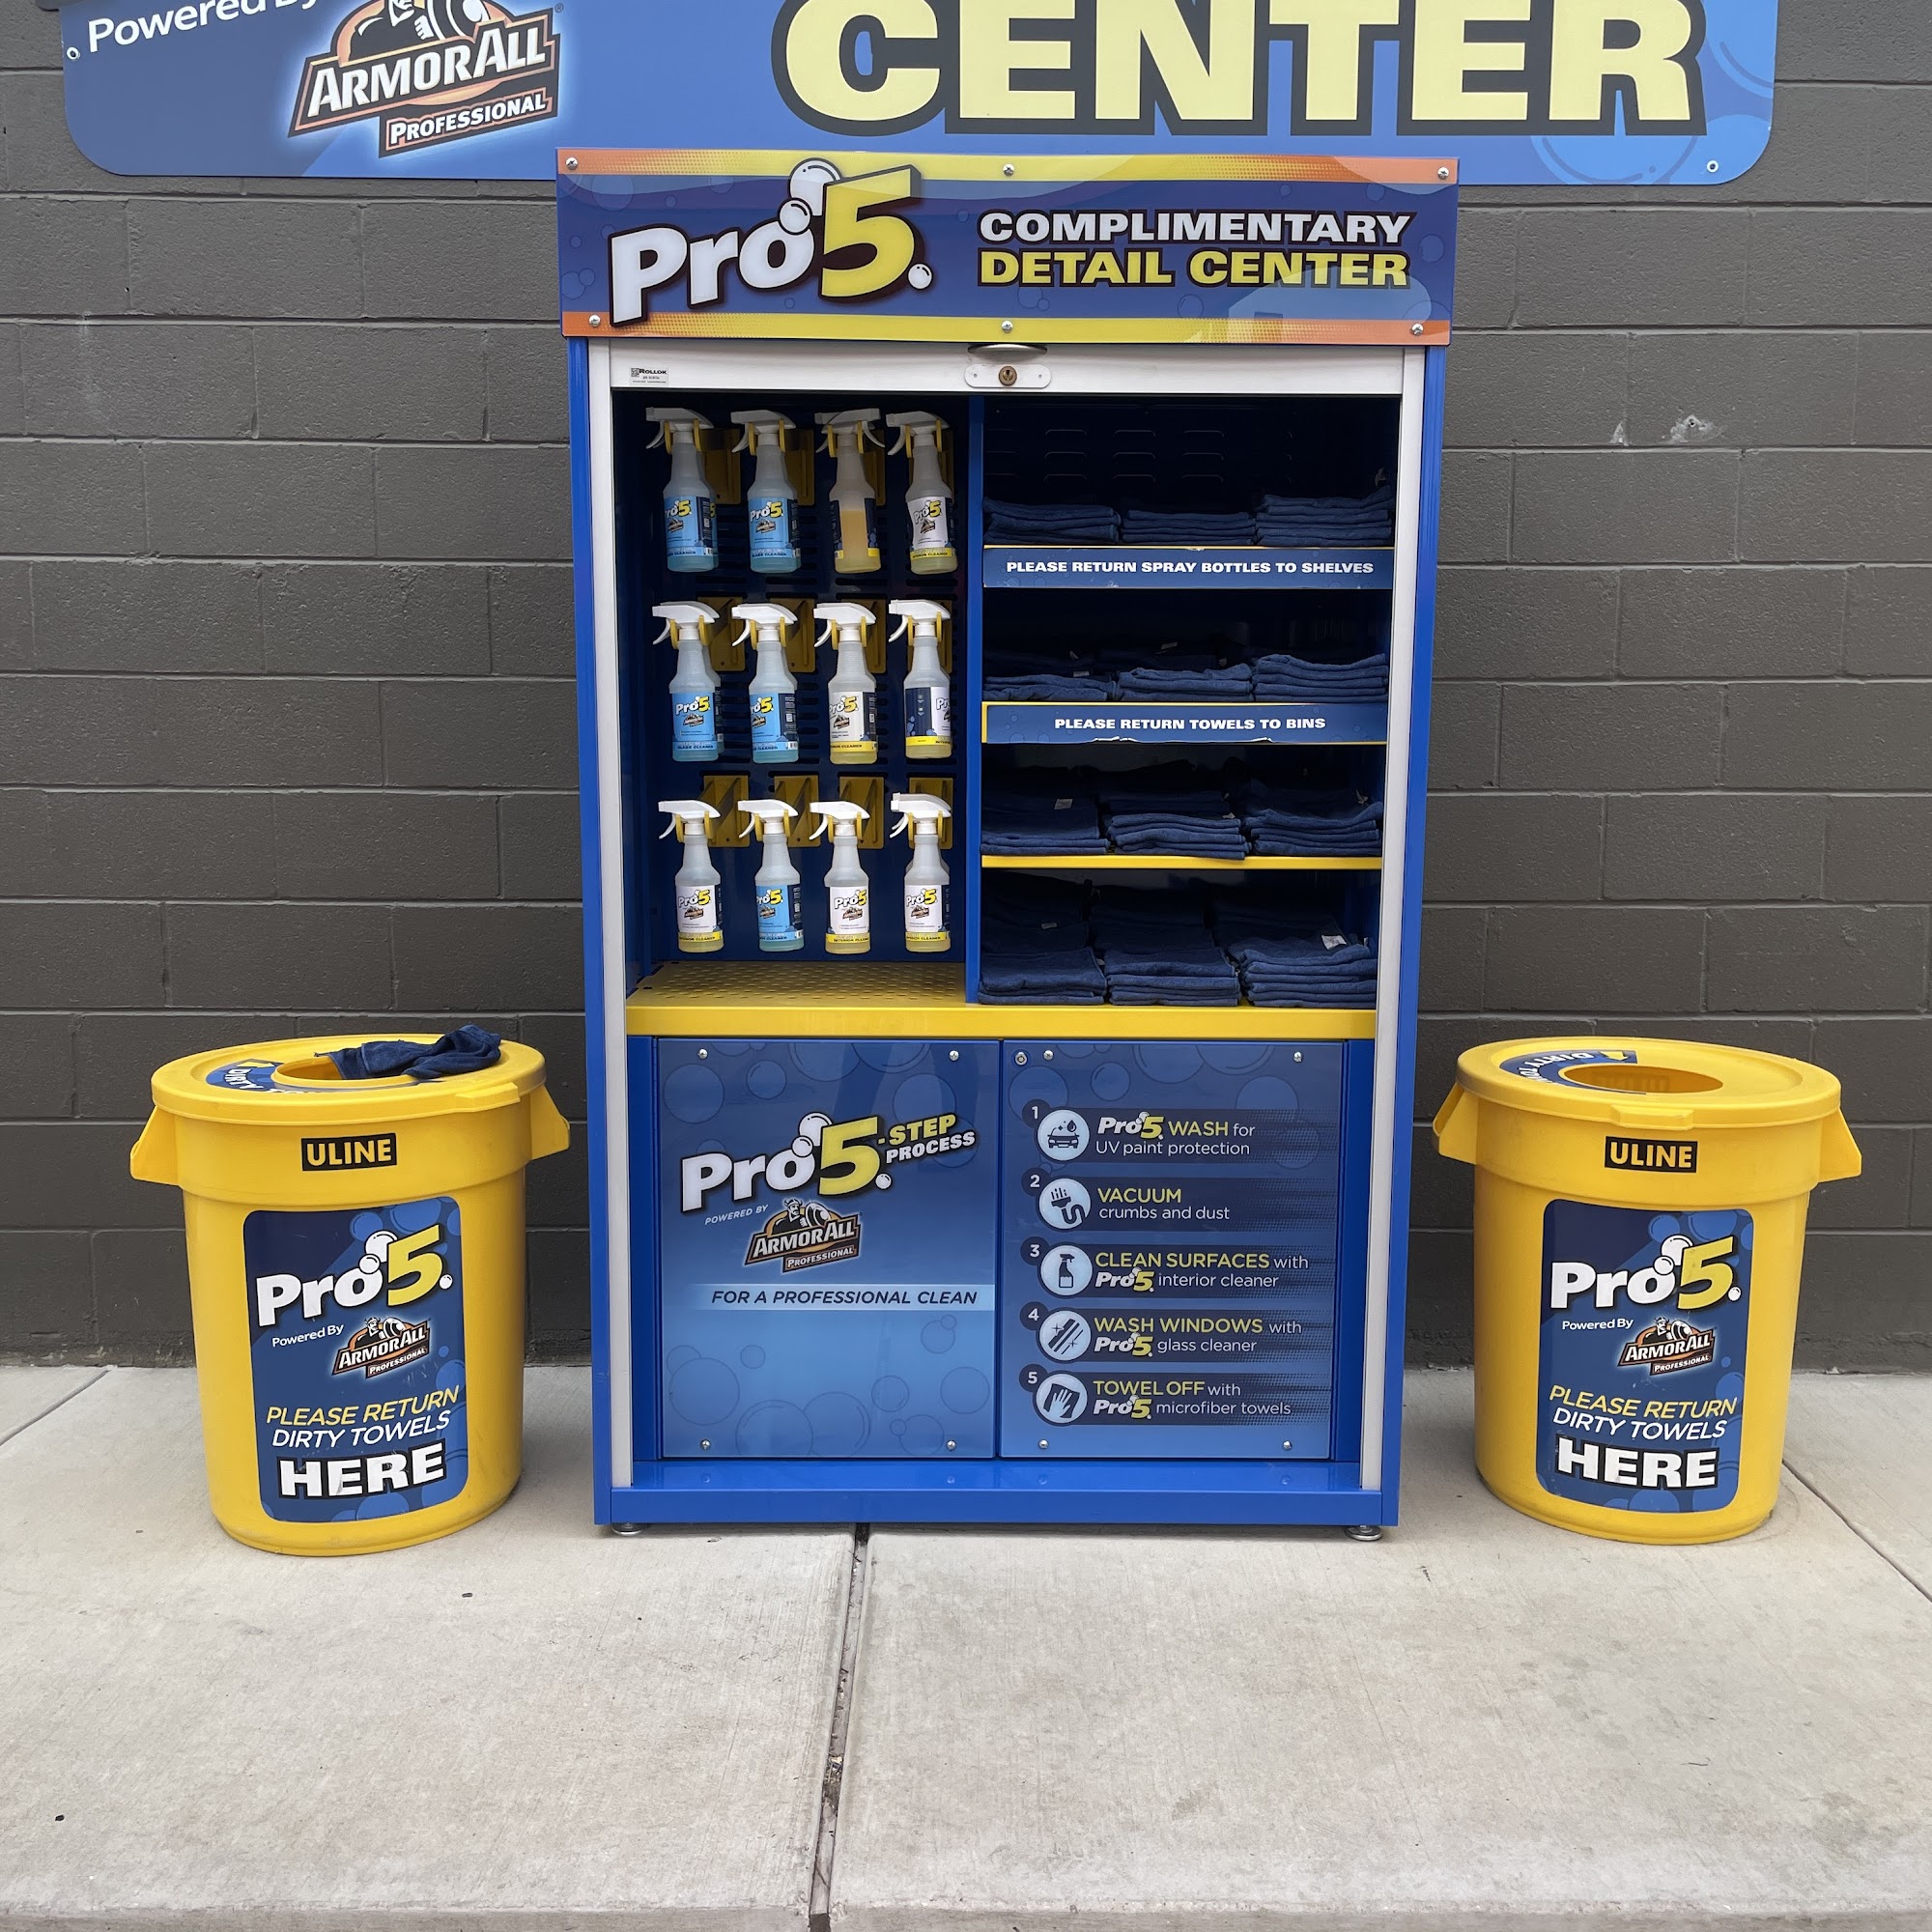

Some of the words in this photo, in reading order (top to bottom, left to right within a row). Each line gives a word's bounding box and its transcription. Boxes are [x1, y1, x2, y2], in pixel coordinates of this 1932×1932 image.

[786, 0, 1692, 123] CENTER
[390, 94, 547, 145] PROFESSIONAL
[979, 212, 1411, 244] COMPLIMENTARY
[980, 249, 1174, 285] DETAIL
[1188, 251, 1409, 287] CENTER
[1006, 561, 1067, 573] PLEASE
[1071, 561, 1137, 573] RETURN
[1140, 561, 1197, 574] SPRAY
[1201, 562, 1271, 574] BOTTLES
[1274, 562, 1297, 574] TO
[1301, 562, 1375, 575] SHELVES
[1054, 718, 1116, 730] PLEASE
[1120, 718, 1185, 730] RETURN
[1189, 718, 1256, 730] TOWELS
[1259, 718, 1282, 730] TO
[1286, 718, 1326, 729] BINS
[1031, 1105, 1039, 1120] 1
[1167, 1121, 1230, 1137] WASH
[1233, 1122, 1256, 1137] for
[305, 1137, 392, 1167] ULINE
[885, 1130, 977, 1165] PROCESS
[1094, 1141, 1121, 1154] UV
[1122, 1141, 1164, 1157] paint
[1167, 1141, 1251, 1157] protection
[1608, 1141, 1693, 1169] ULINE
[1029, 1175, 1040, 1188] 2
[1096, 1187, 1182, 1204] VACUUM
[704, 1208, 753, 1226] POWERED
[753, 1204, 770, 1214] BY
[1098, 1205, 1158, 1220] crumbs
[1161, 1206, 1192, 1220] and
[1195, 1206, 1231, 1220] dust
[786, 1246, 855, 1269] PROFESSIONAL
[1029, 1244, 1040, 1258] 3
[1094, 1252, 1162, 1268] CLEAN
[1165, 1253, 1270, 1269] SURFACES
[1273, 1255, 1310, 1269] with
[1157, 1272, 1217, 1288] interior
[1220, 1273, 1280, 1289] cleaner
[711, 1290, 749, 1305] FOR
[753, 1290, 768, 1305] A
[773, 1290, 912, 1305] PROFESSIONAL
[917, 1290, 978, 1305] CLEAN
[1027, 1308, 1040, 1321] 4
[1094, 1317, 1154, 1333] WASH
[1158, 1318, 1264, 1334] WINDOWS
[1268, 1321, 1303, 1335] with
[1561, 1318, 1616, 1331] Powered
[1616, 1318, 1634, 1333] By
[270, 1328, 327, 1349] Powered
[326, 1324, 345, 1339] By
[1157, 1338, 1197, 1353] glass
[1200, 1338, 1258, 1352] cleaner
[368, 1347, 428, 1376] PROFESSIONAL
[1653, 1353, 1710, 1374] PROFESSIONAL
[1026, 1372, 1038, 1385] 5
[1093, 1379, 1164, 1397] TOWEL
[1165, 1380, 1206, 1397] OFF
[1207, 1382, 1241, 1397] with
[266, 1406, 356, 1428] PLEASE
[361, 1384, 461, 1424] RETURN
[1155, 1401, 1237, 1416] microfiber
[1240, 1401, 1293, 1416] towels
[1548, 1383, 1641, 1418] PLEASE
[1642, 1396, 1739, 1421] RETURN
[270, 1428, 345, 1449] DIRTY
[350, 1408, 452, 1447] TOWELS
[1551, 1406, 1628, 1436] DIRTY
[1631, 1417, 1729, 1442] TOWELS
[278, 1441, 445, 1498] HERE
[1556, 1435, 1718, 1490] HERE
